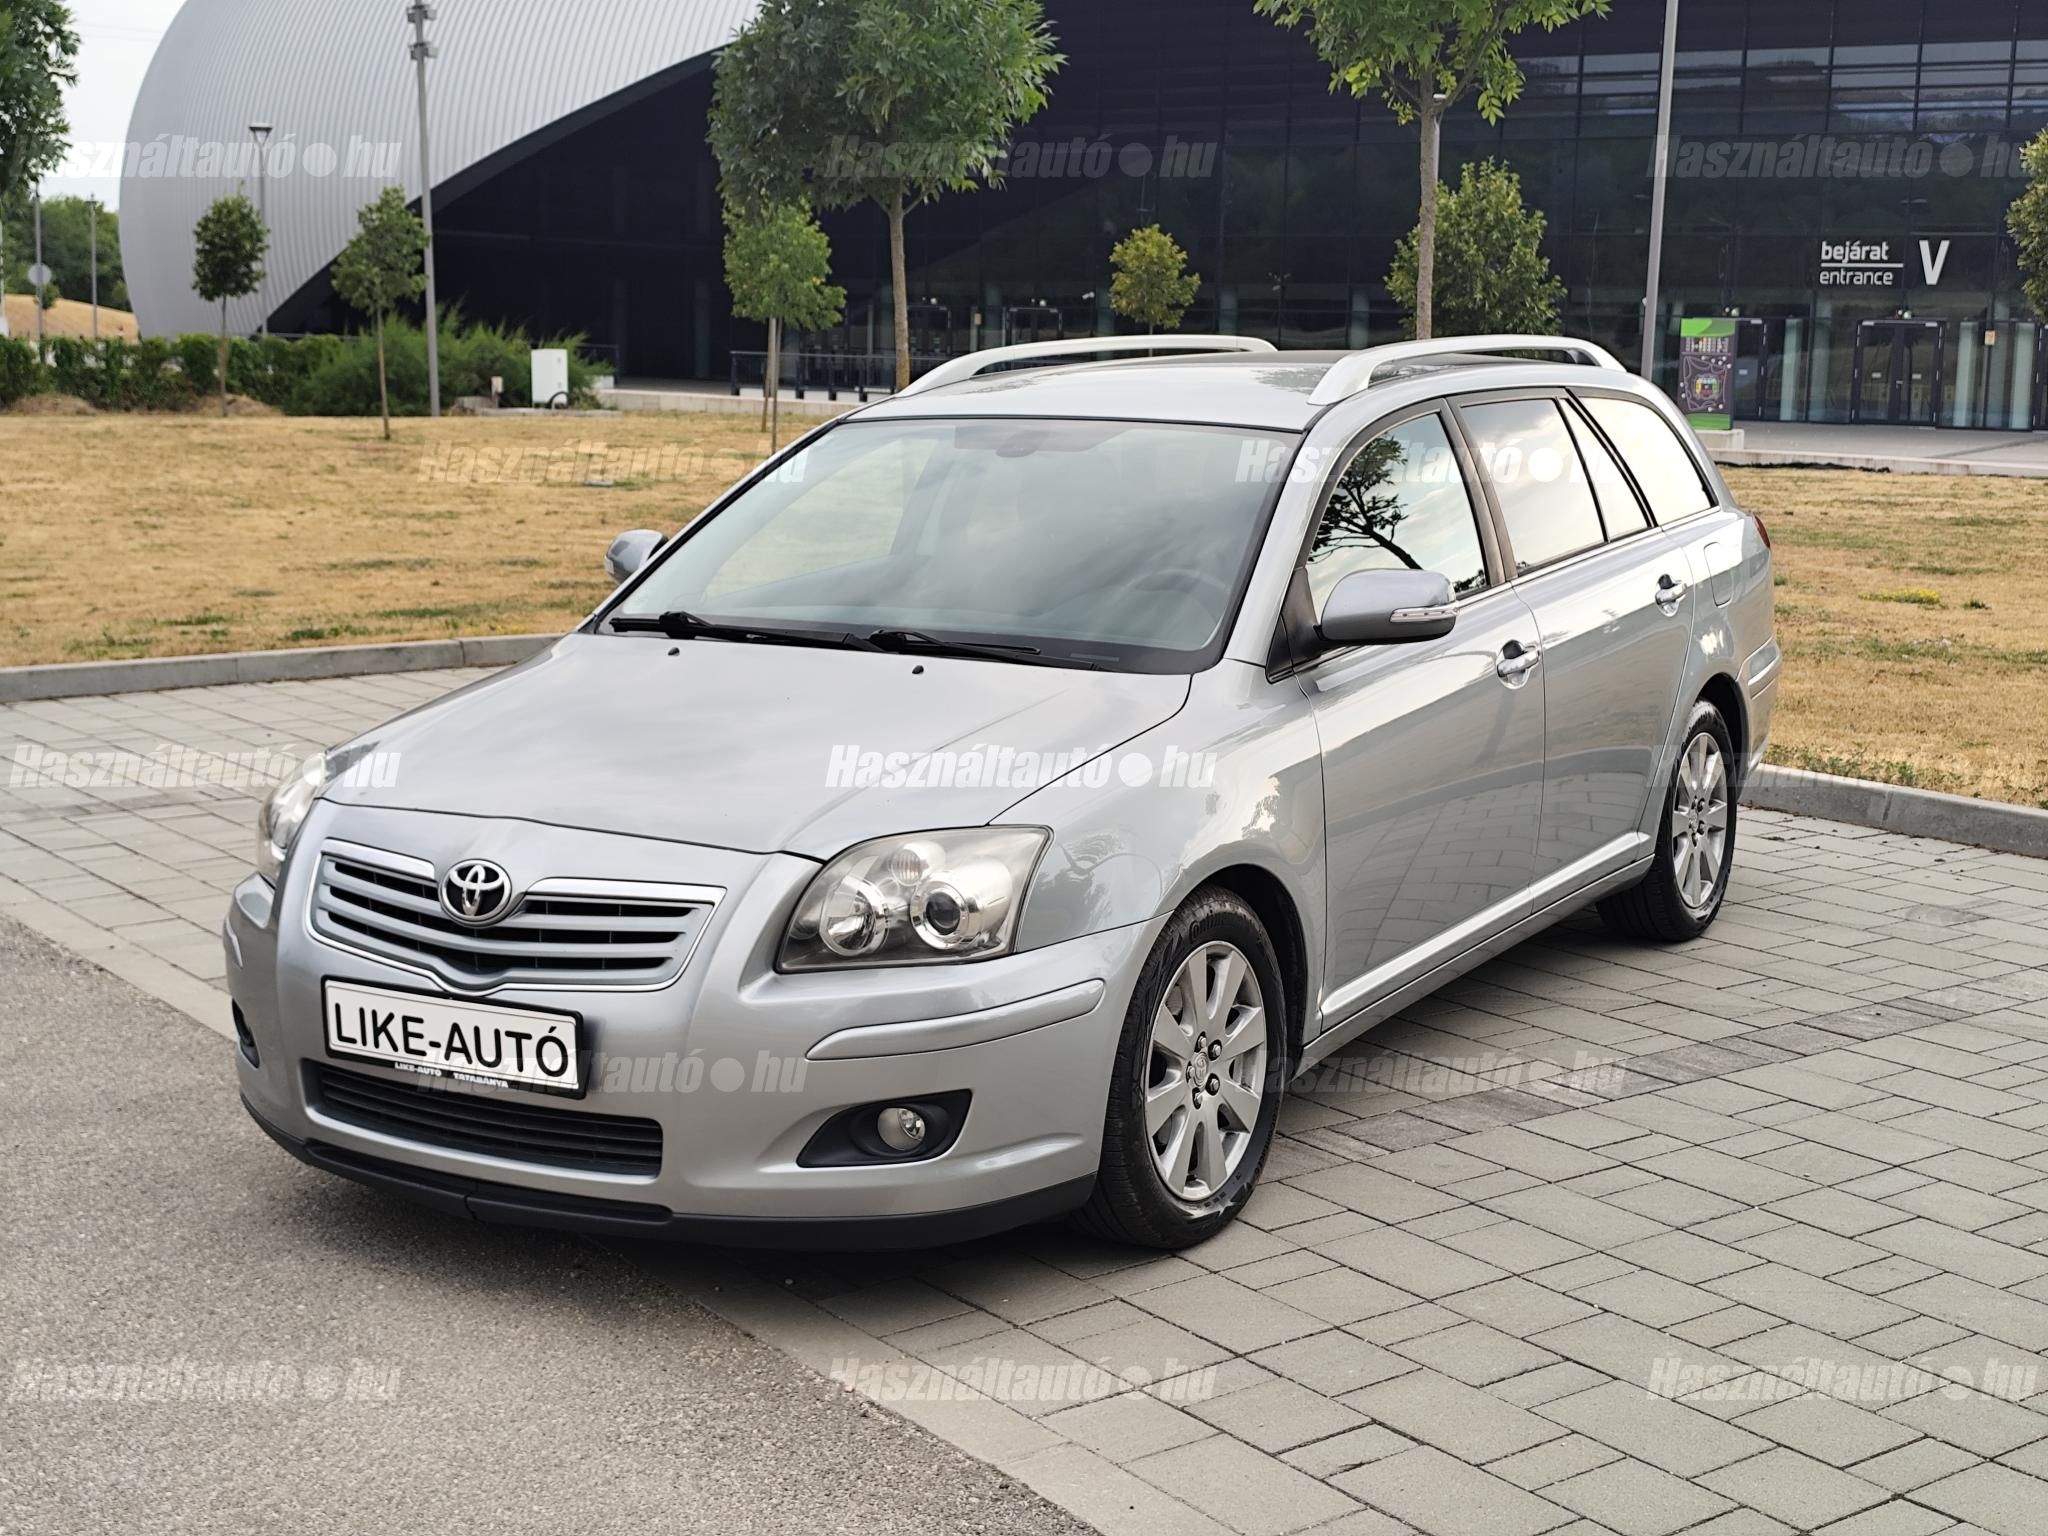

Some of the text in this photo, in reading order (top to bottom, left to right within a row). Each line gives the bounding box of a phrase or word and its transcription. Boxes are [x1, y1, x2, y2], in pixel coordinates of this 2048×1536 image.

[1821, 240, 1889, 264] bejárat
[1919, 240, 1950, 285] V
[1819, 268, 1893, 285] entrance
[334, 1003, 569, 1077] LIKE-AUTÓ
